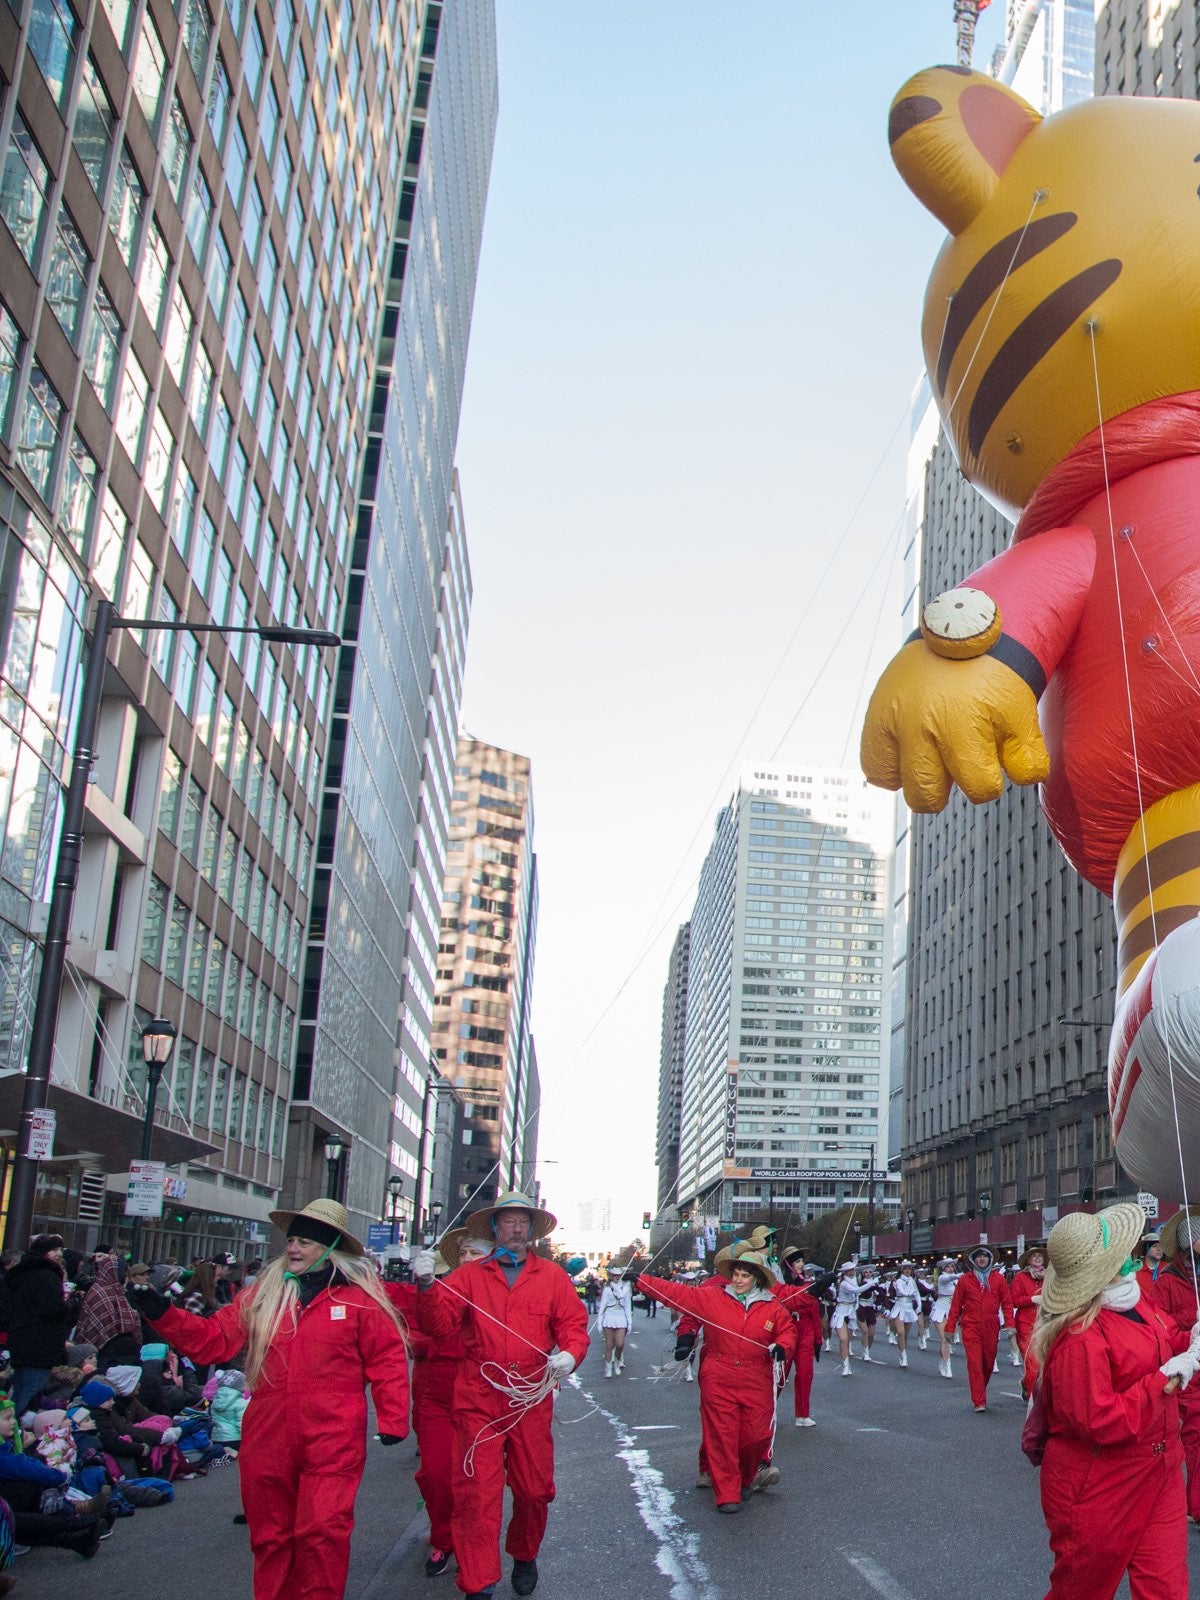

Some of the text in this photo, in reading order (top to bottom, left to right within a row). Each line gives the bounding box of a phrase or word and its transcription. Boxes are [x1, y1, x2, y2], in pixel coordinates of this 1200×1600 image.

[726, 1074, 737, 1157] LUXURY
[34, 1141, 48, 1149] ONLY
[1142, 1206, 1156, 1216] 25
